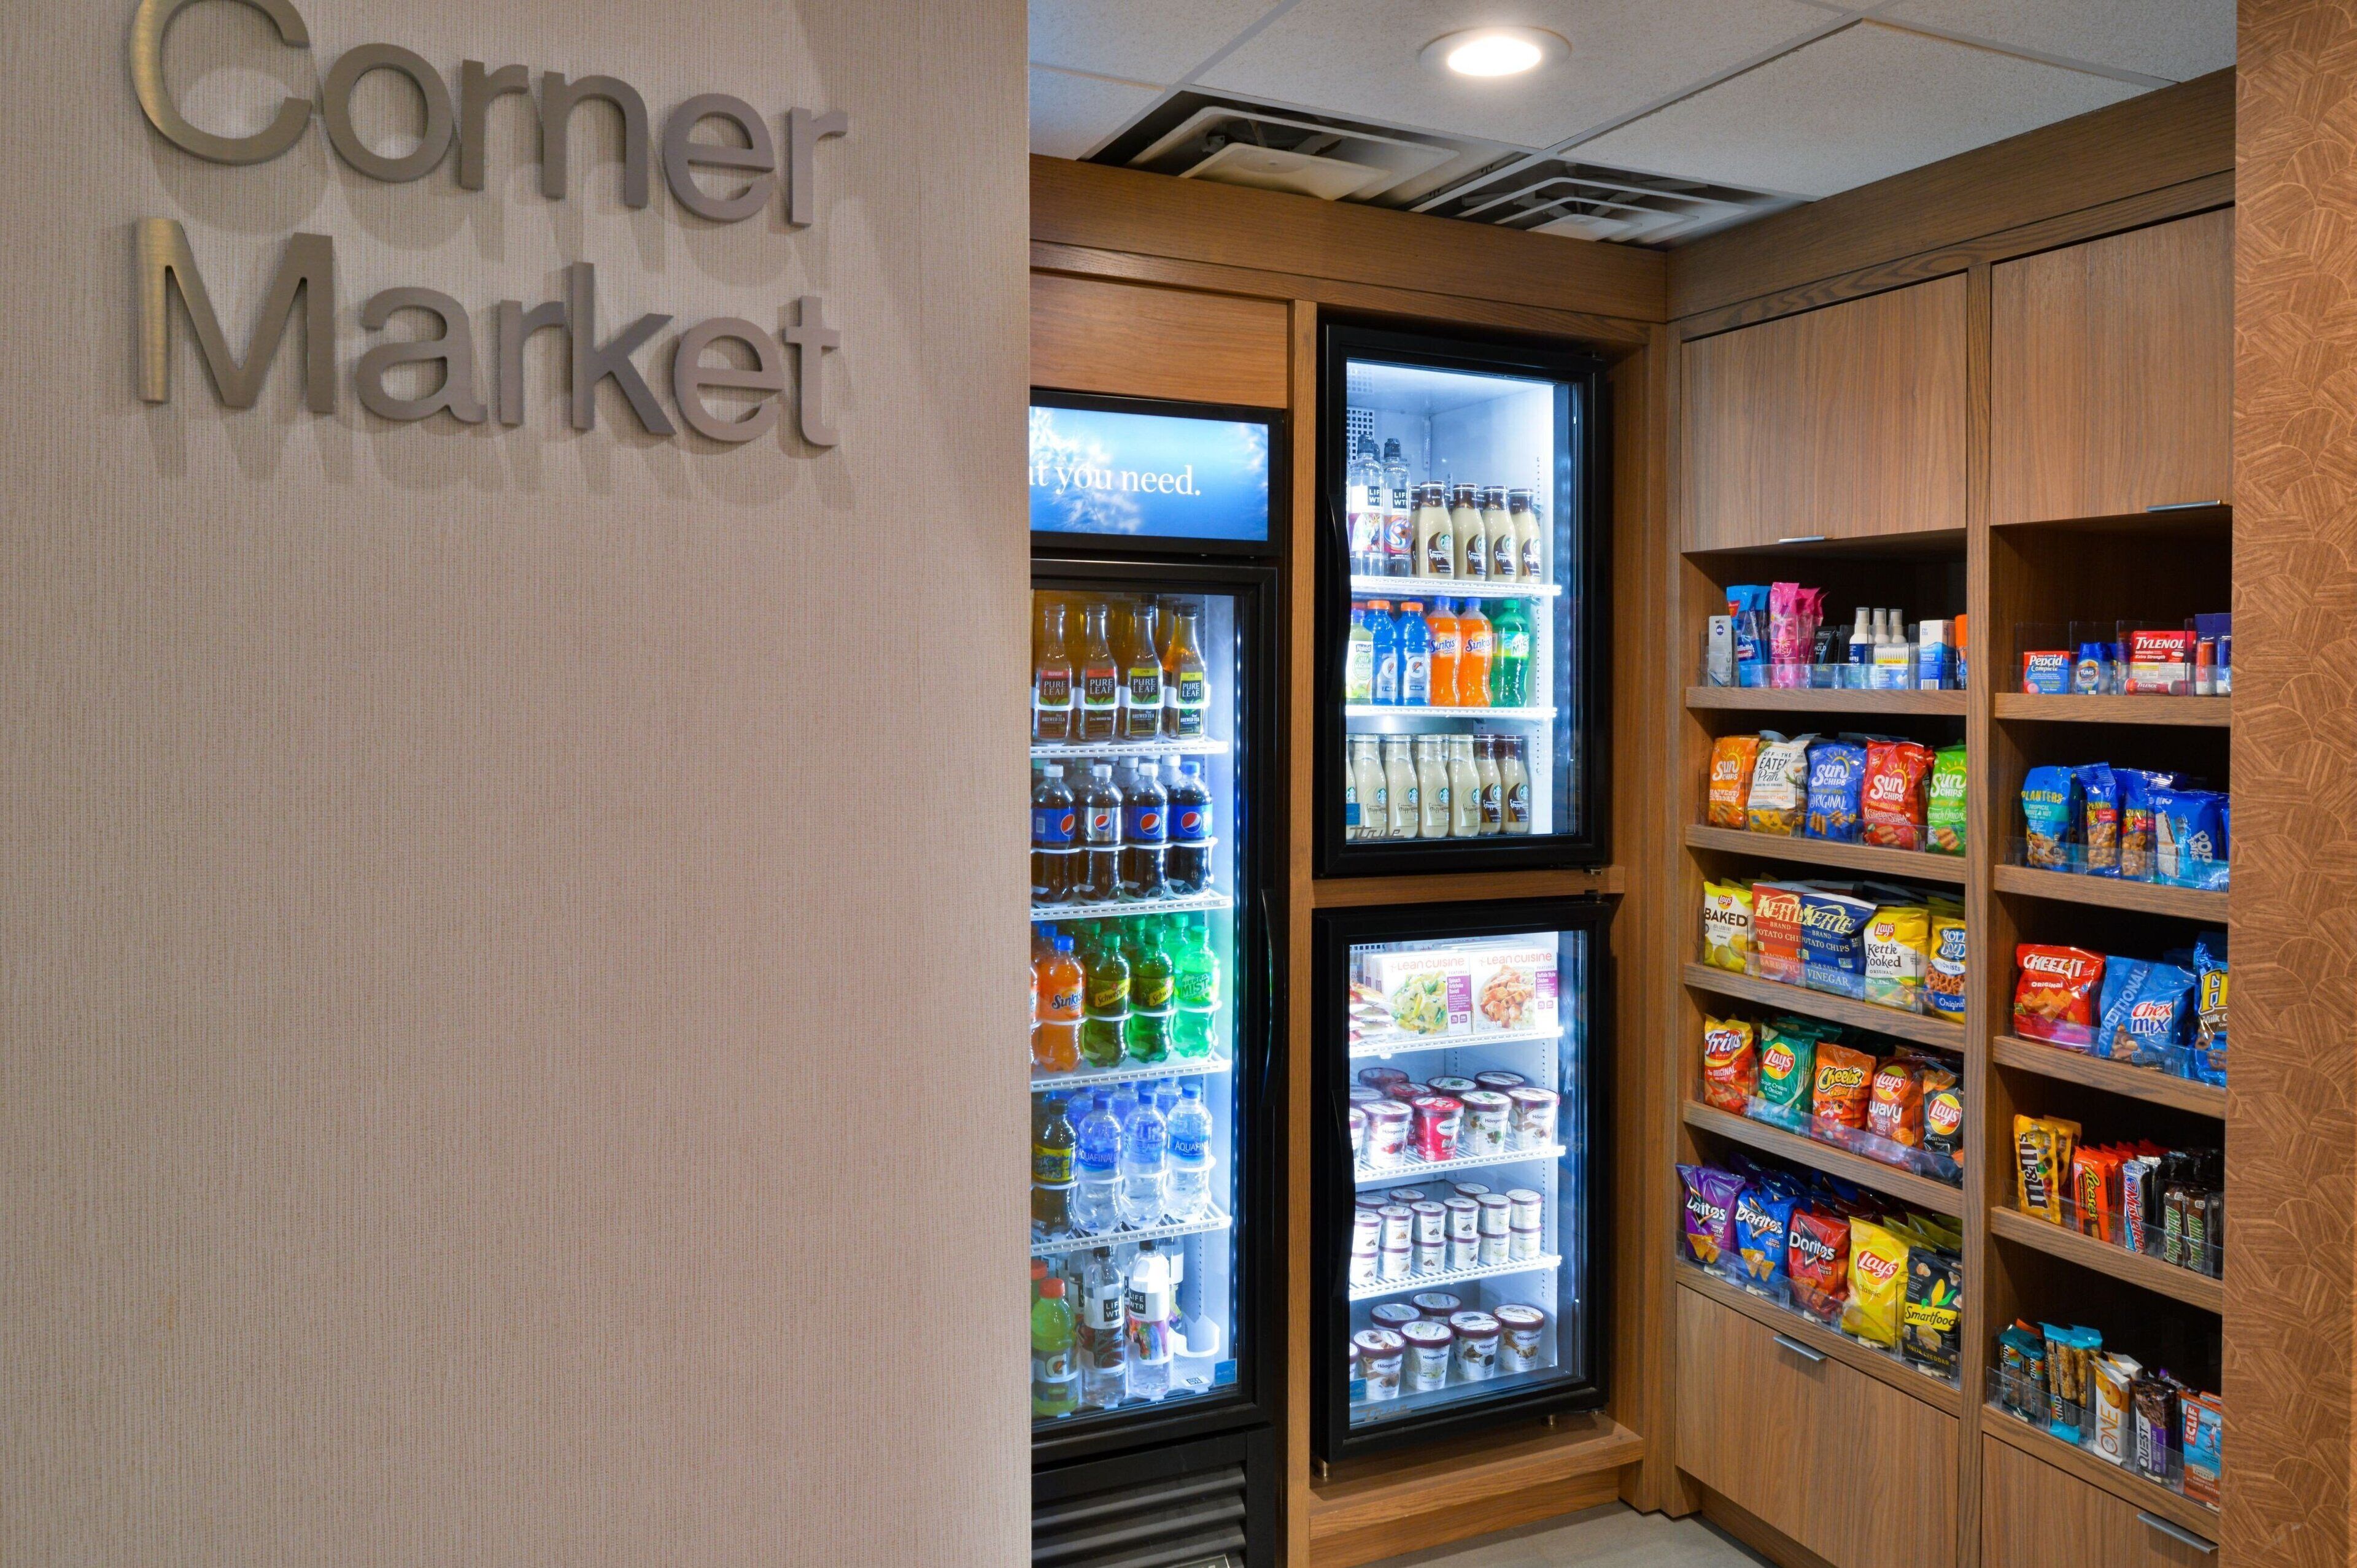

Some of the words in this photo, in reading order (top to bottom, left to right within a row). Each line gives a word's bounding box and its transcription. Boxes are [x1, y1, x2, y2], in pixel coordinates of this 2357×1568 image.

[131, 0, 848, 228] Corner
[136, 217, 840, 447] Market
[1055, 465, 1112, 494] you
[1122, 465, 1201, 495] need.
[2135, 637, 2184, 650] TYLENOL
[2029, 655, 2062, 667] Pepcid
[1713, 760, 1738, 781] Sun
[1811, 764, 1849, 786] Sun
[1870, 774, 1905, 800] Sun
[1883, 791, 1903, 801] CHIPS
[1930, 773, 1966, 798] Sun
[1940, 789, 1963, 797] CHIPS
[1811, 795, 1848, 809] ORIGINAL
[2021, 790, 2063, 804] PLANTERS
[1719, 895, 1732, 905] Lay's
[1705, 908, 1747, 927] BAKED
[1802, 903, 1856, 934] KETTLE
[1756, 928, 1783, 938] POTATO
[1812, 930, 1832, 939] BRAND
[1876, 922, 1894, 937] Lay's
[1826, 943, 1850, 952] CHIPS
[1867, 943, 1897, 957] Kettle
[1398, 961, 1424, 971] Lean
[1426, 957, 1465, 968] cuisine
[1487, 955, 1514, 965] Lean
[1515, 952, 1552, 964] cuisine
[1808, 968, 1848, 986] VINEGAR
[1182, 979, 1209, 997] MIST
[2099, 967, 2149, 1045] TRADITIONAL
[2132, 1002, 2173, 1017] Chex
[1705, 1030, 1742, 1056] Fritos
[1713, 1065, 1736, 1076] ORIGINAL
[1764, 1049, 1793, 1072] Lay's
[1772, 1083, 1787, 1092] Cream
[1818, 1067, 1863, 1092] Cheetos
[1876, 1073, 1905, 1091] Lay's
[1768, 1086, 1782, 1096] Onion
[1869, 1100, 1902, 1124] wavy
[1930, 1100, 1960, 1125] Lay's
[2084, 1166, 2100, 1221] Reese's
[1735, 1206, 1783, 1234] Doritos
[2165, 1205, 2181, 1239] Milky
[2187, 1213, 2205, 1248] Milky
[1789, 1232, 1836, 1261] Doritos
[2164, 1237, 2181, 1264] Way
[1859, 1252, 1897, 1277] Lay's
[1129, 1292, 1144, 1302] LIFE
[2100, 1404, 2118, 1455] ONE
[2186, 1407, 2198, 1435] CLIF
[2138, 1425, 2149, 1468] QUEST
